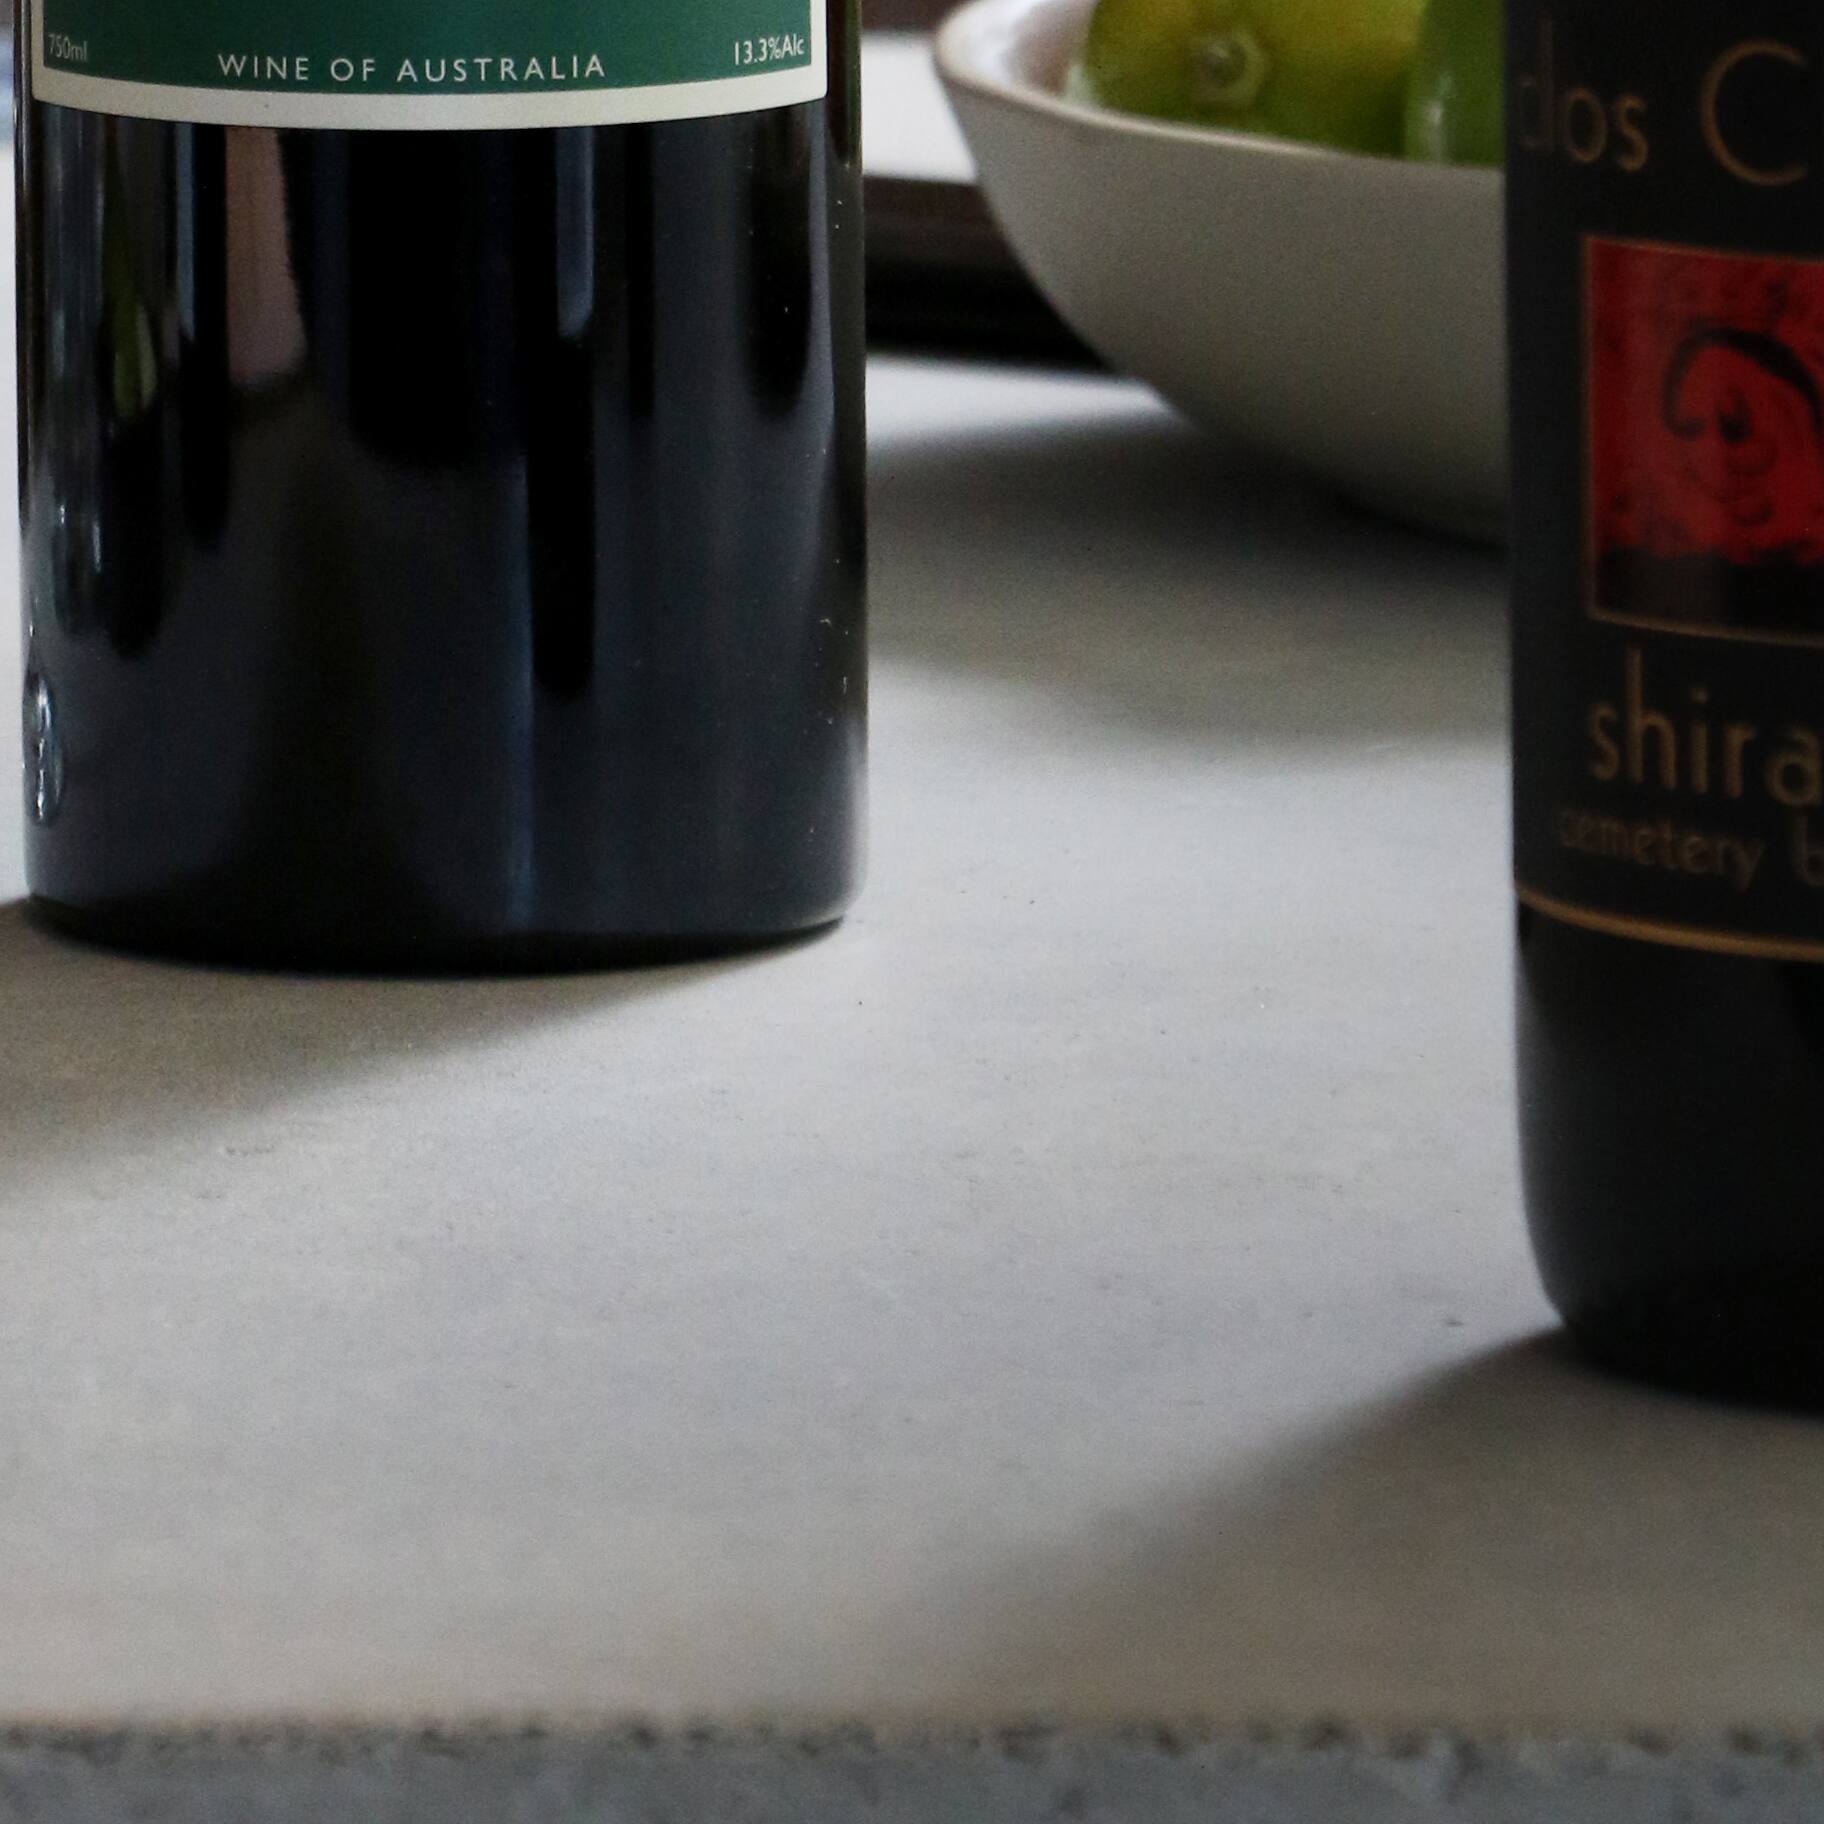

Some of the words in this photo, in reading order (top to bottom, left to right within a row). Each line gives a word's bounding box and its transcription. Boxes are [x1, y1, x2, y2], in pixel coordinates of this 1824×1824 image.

[47, 33, 89, 65] 750ml
[732, 33, 806, 66] 13.3%Alc
[217, 51, 312, 82] WINE
[329, 55, 376, 84] OF
[394, 51, 607, 84] AUSTRALIA
